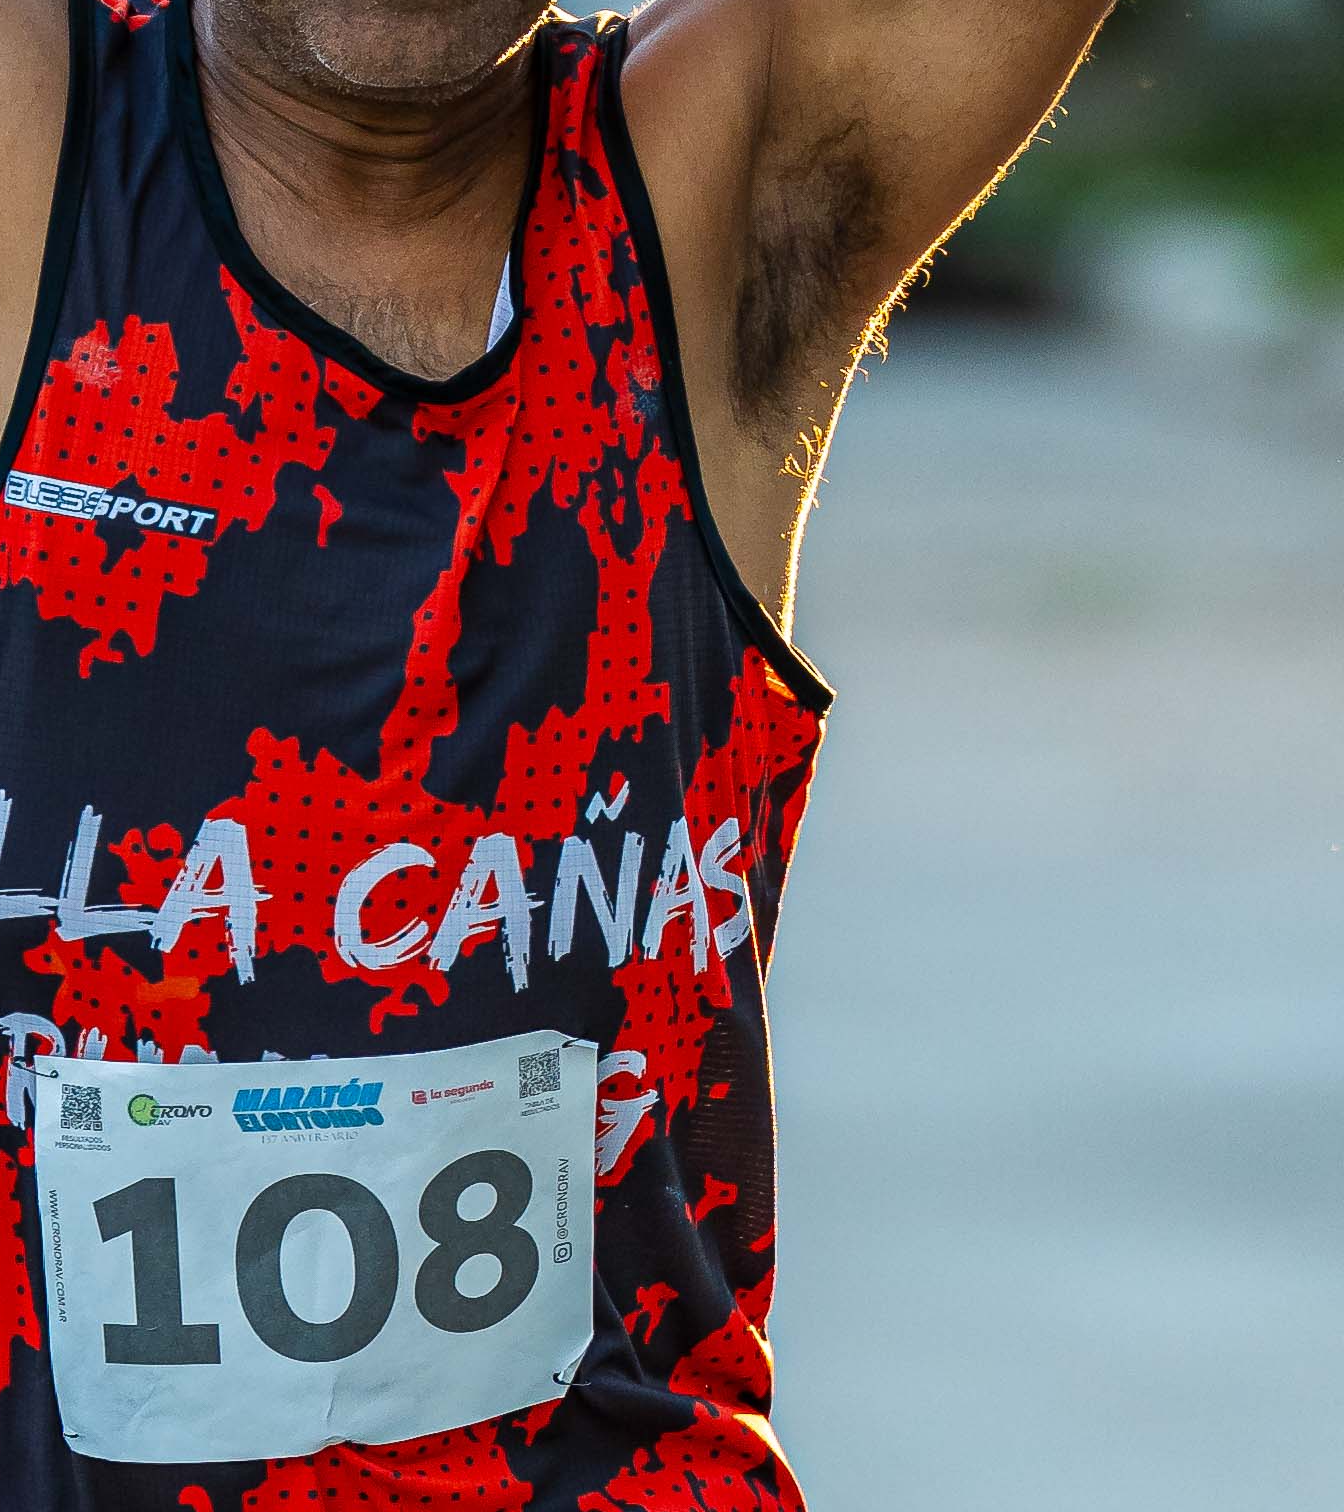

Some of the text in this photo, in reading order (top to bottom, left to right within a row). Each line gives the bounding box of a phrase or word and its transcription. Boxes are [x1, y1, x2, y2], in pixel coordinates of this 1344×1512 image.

[333, 769, 754, 994] CAÑAS
[232, 1077, 384, 1112] MARATÓN
[431, 1088, 442, 1100] la
[444, 1079, 495, 1098] segunda
[150, 1104, 213, 1120] CRONO
[92, 1149, 540, 1366] 108
